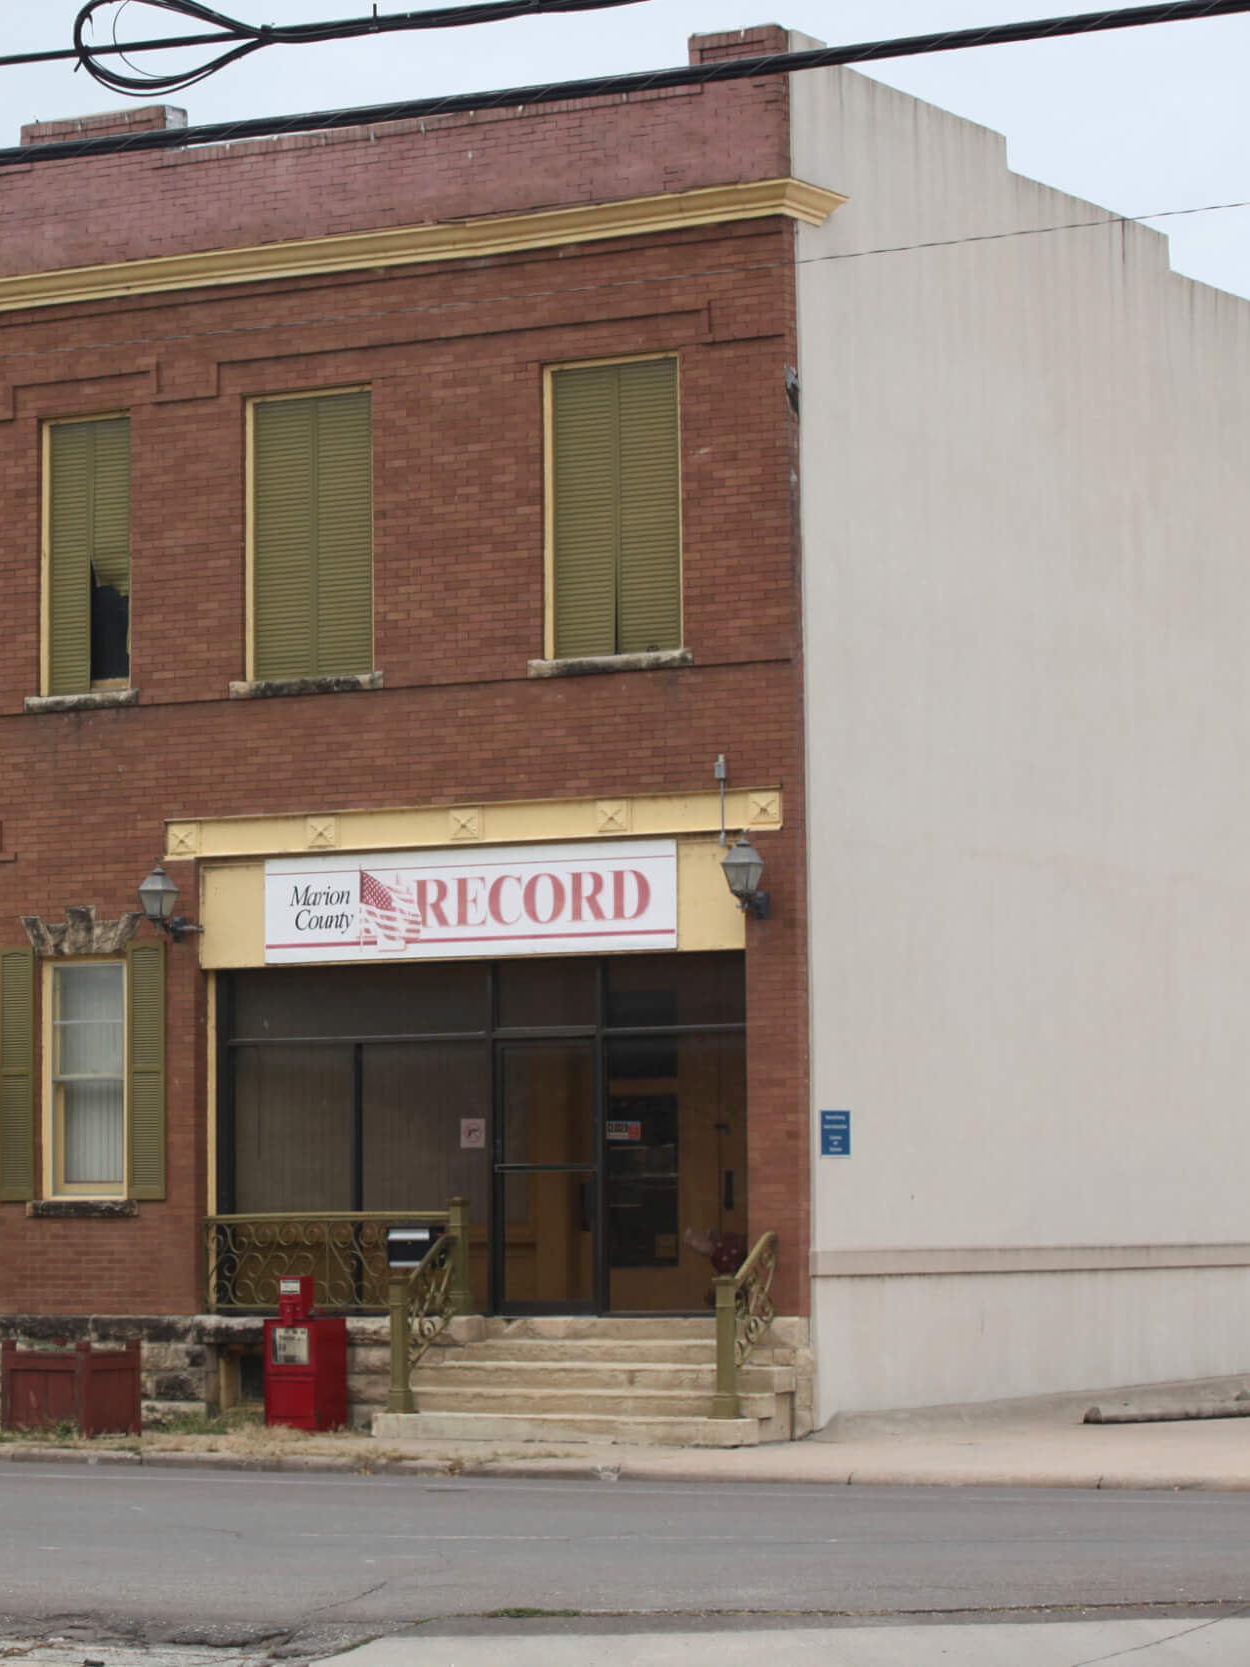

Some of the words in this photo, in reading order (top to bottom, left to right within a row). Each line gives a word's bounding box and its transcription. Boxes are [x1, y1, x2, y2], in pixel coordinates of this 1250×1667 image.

[290, 884, 350, 906] Marion
[415, 869, 652, 929] RECORD
[295, 908, 354, 934] County
